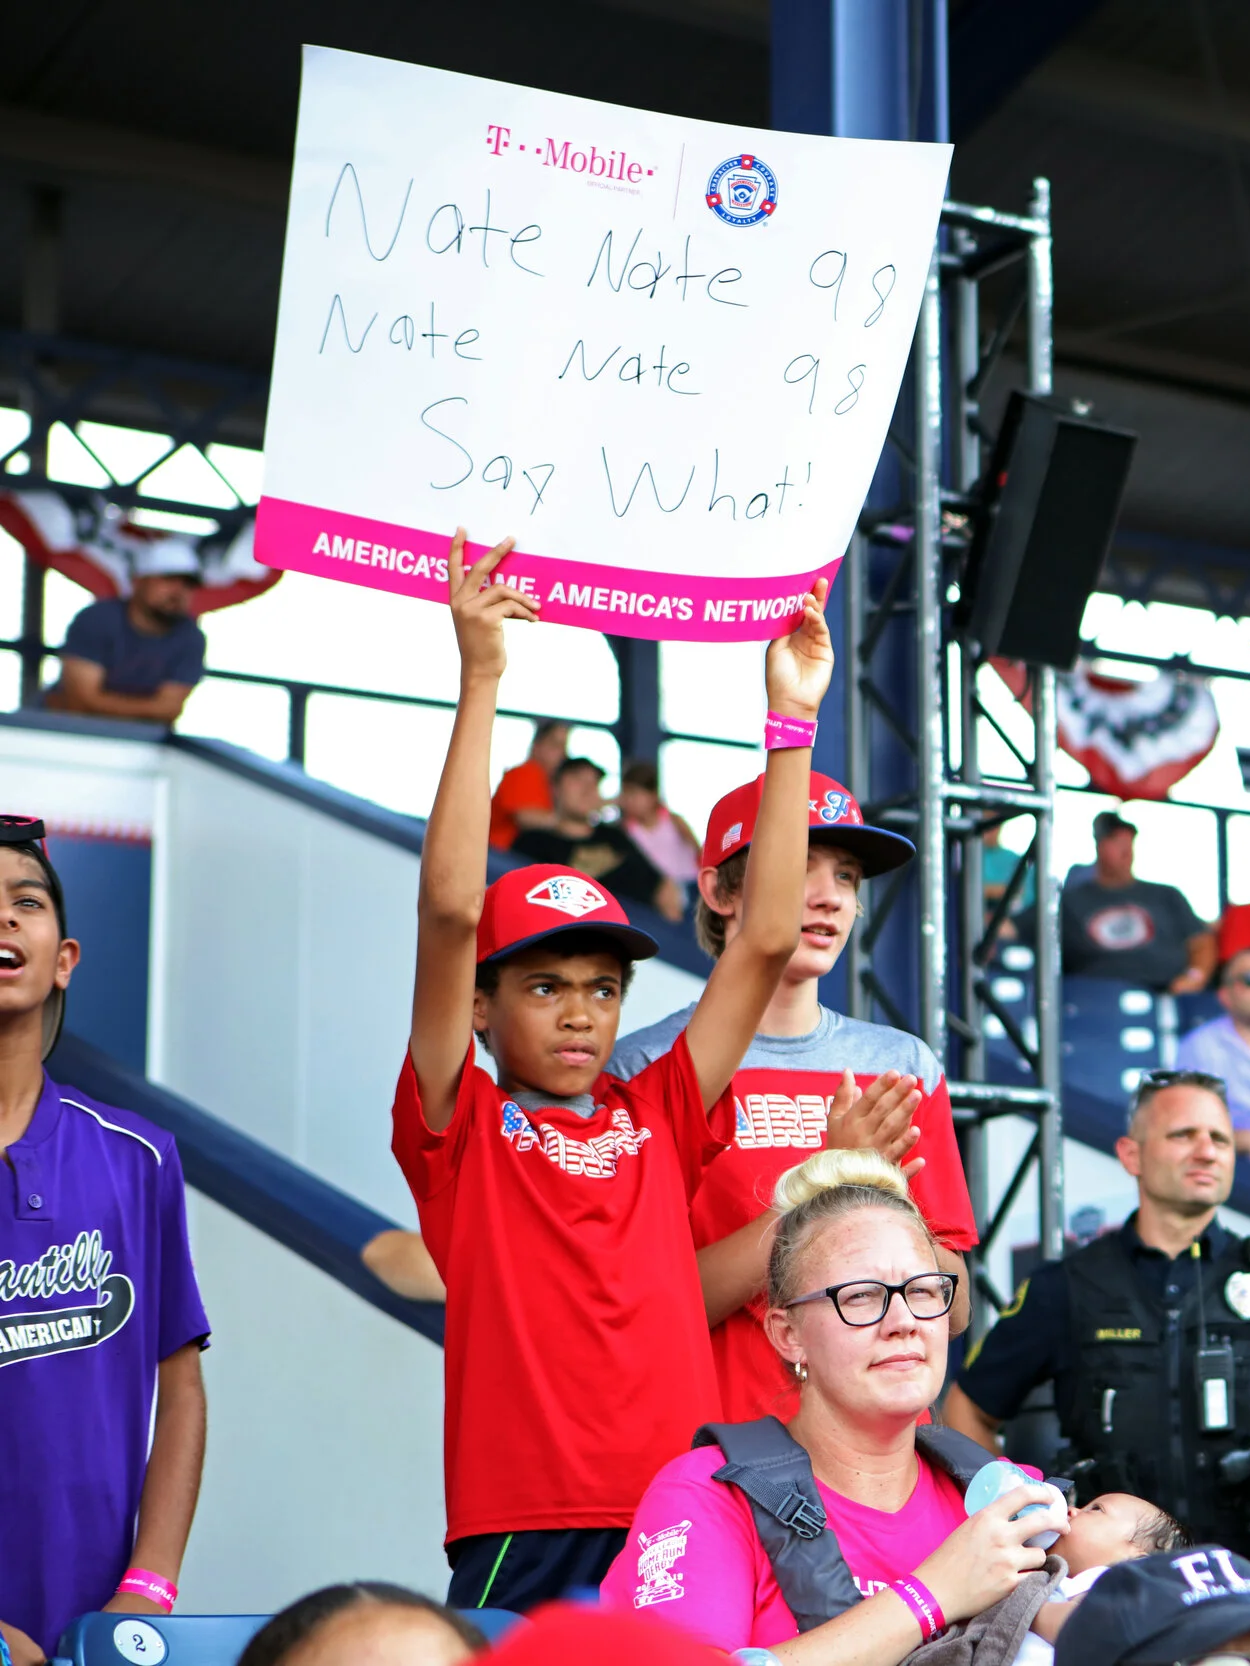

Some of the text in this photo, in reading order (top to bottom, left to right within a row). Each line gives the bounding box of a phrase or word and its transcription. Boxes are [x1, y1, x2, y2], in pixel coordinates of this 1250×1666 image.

[710, 160, 739, 193] CHARACTER
[755, 163, 776, 198] COURAGE
[326, 163, 545, 277] Nate
[587, 228, 749, 307] Nate
[721, 212, 758, 225] LOYALTY
[319, 293, 484, 361] Nate
[558, 340, 702, 395] Nate
[420, 397, 555, 516] Say
[312, 531, 449, 583] AMERICA'S
[547, 582, 694, 621] AMERICA'S
[662, 1546, 683, 1559] RUN
[148, 1582, 173, 1601] LITTLE
[904, 1583, 925, 1606] LITTLE
[132, 1633, 147, 1653] 2
